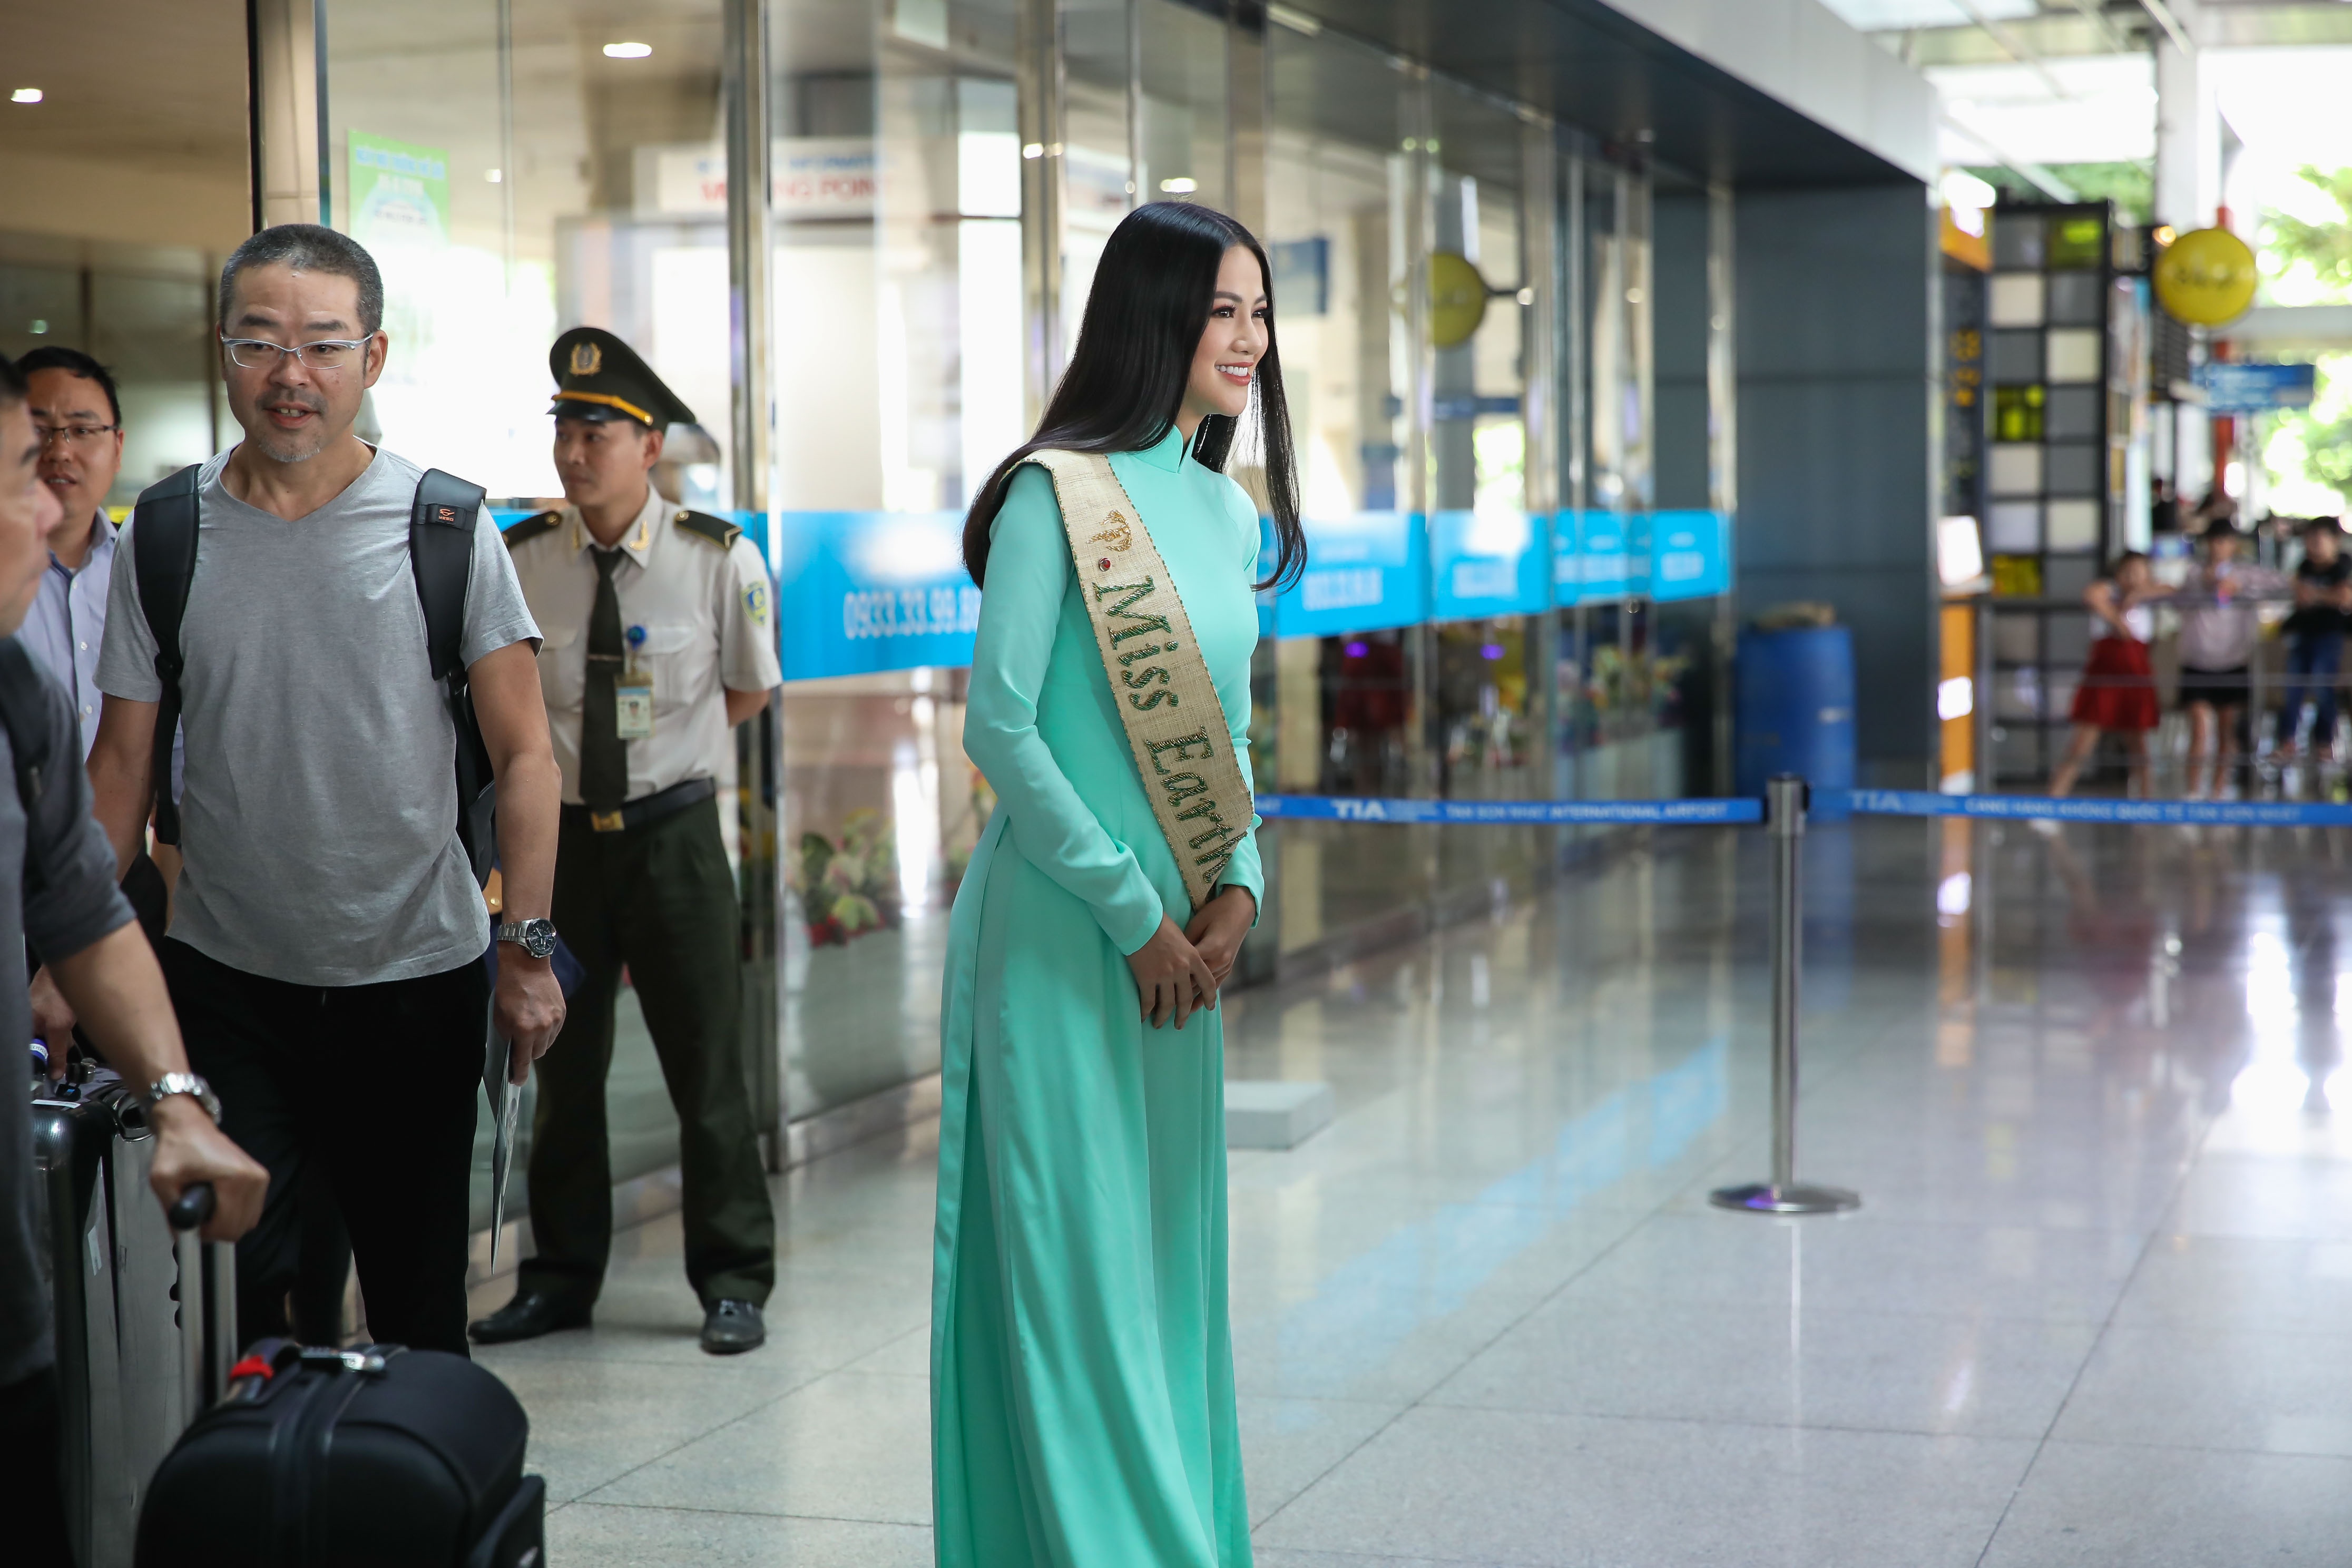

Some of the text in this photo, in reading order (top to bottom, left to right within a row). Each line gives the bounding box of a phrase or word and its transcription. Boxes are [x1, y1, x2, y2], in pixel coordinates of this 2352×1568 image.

[1092, 575, 1248, 883] Miss Earth
[1330, 799, 1387, 820] TIA
[1850, 791, 1902, 811] TIA
